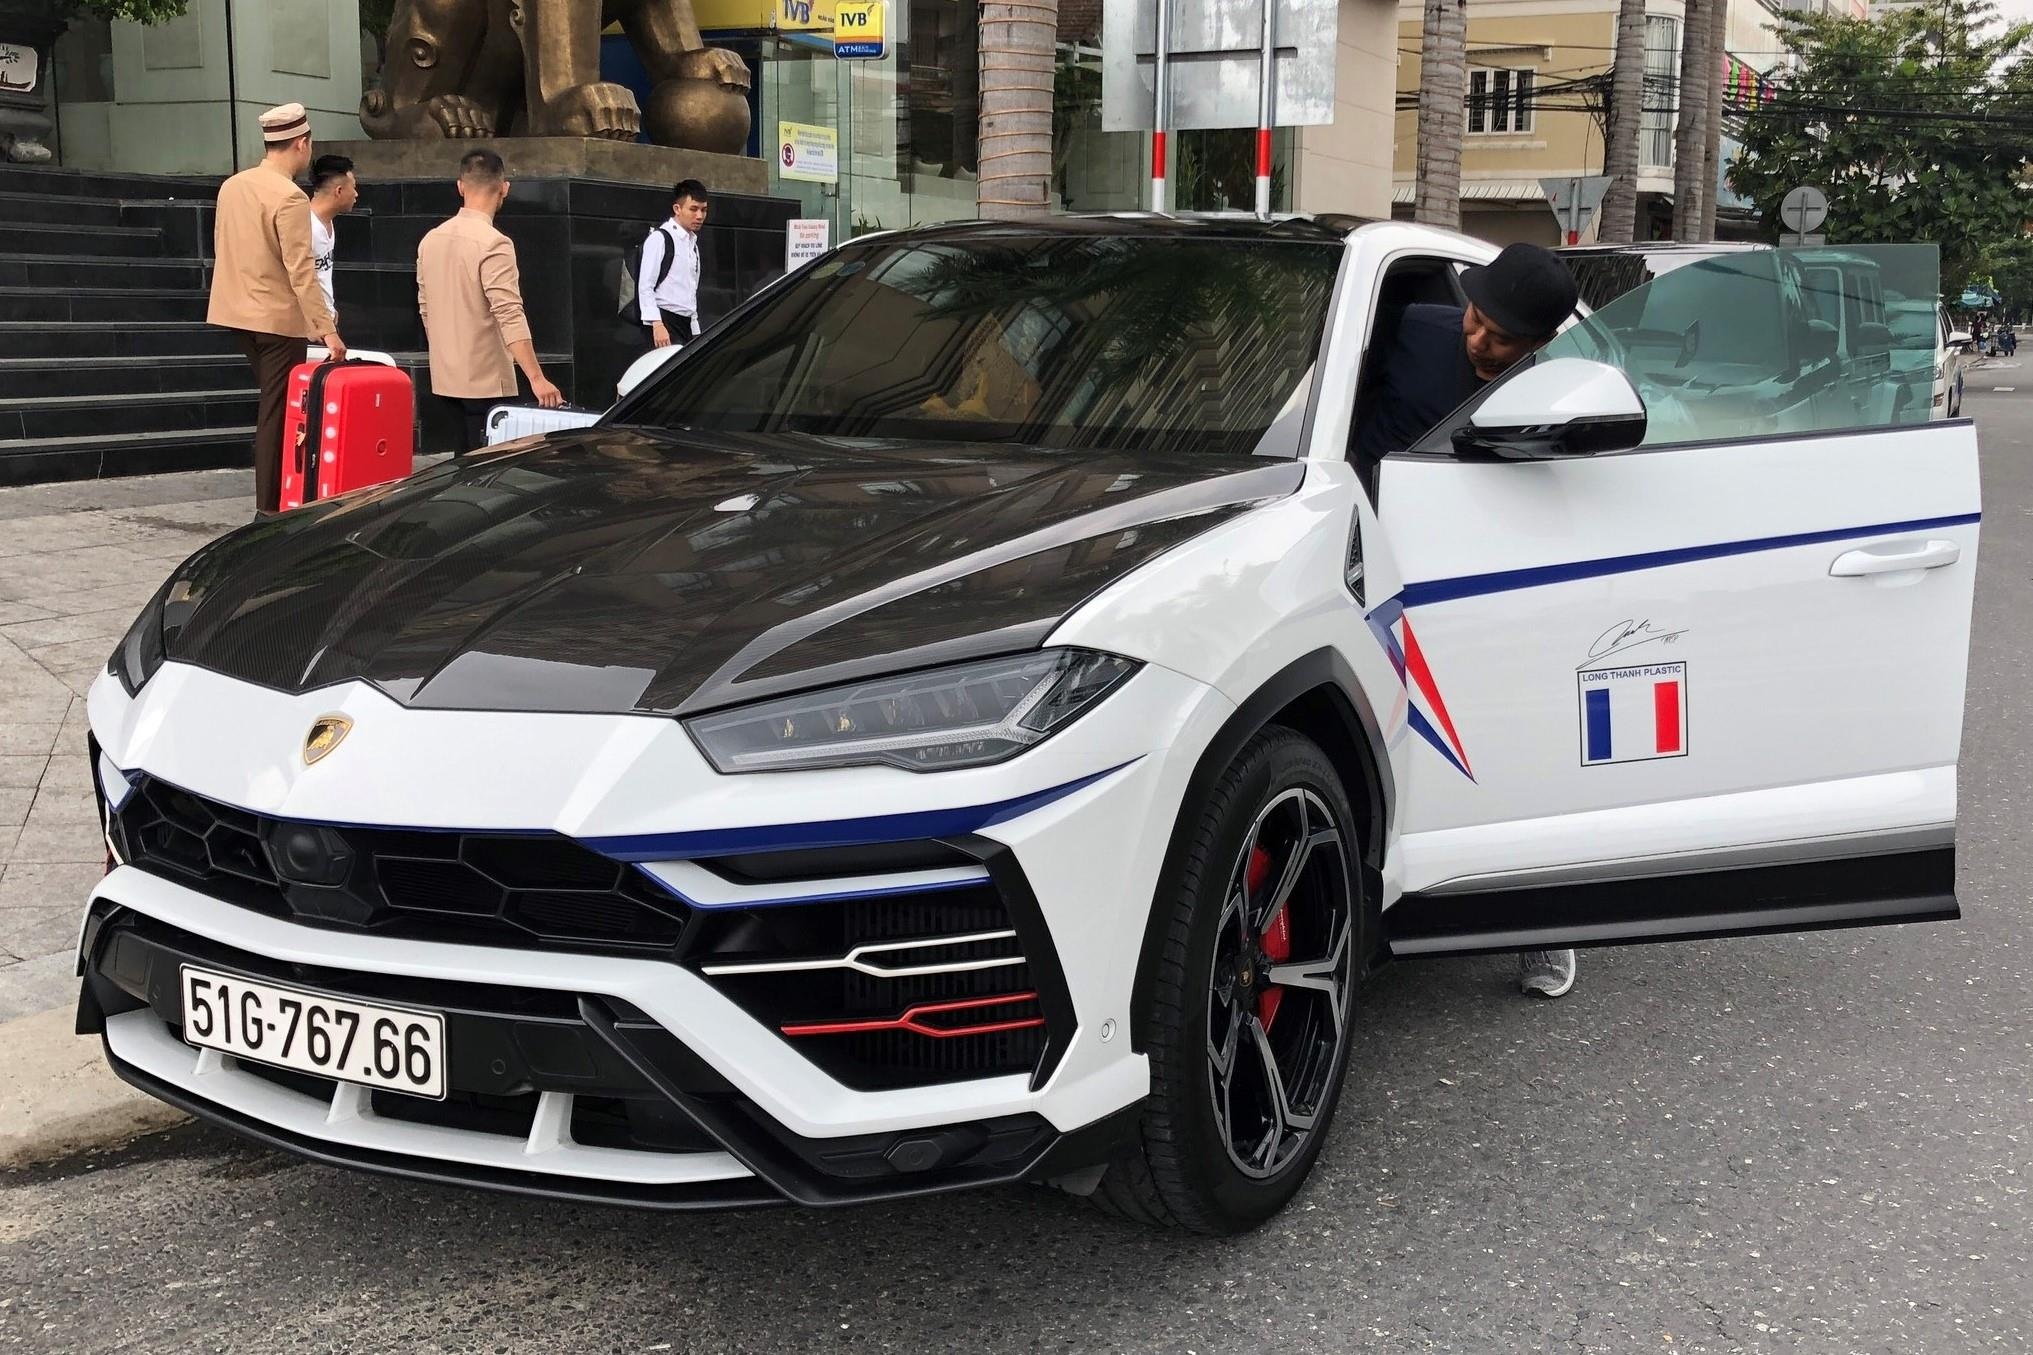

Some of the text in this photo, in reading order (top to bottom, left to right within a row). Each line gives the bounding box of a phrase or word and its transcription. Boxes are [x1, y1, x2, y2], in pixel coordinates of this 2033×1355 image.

[784, 0, 810, 24] IVB
[841, 13, 867, 27] IVB
[1582, 665, 1681, 682] LONG THANH PLASTIC
[190, 977, 431, 1085] 51G-767.66
